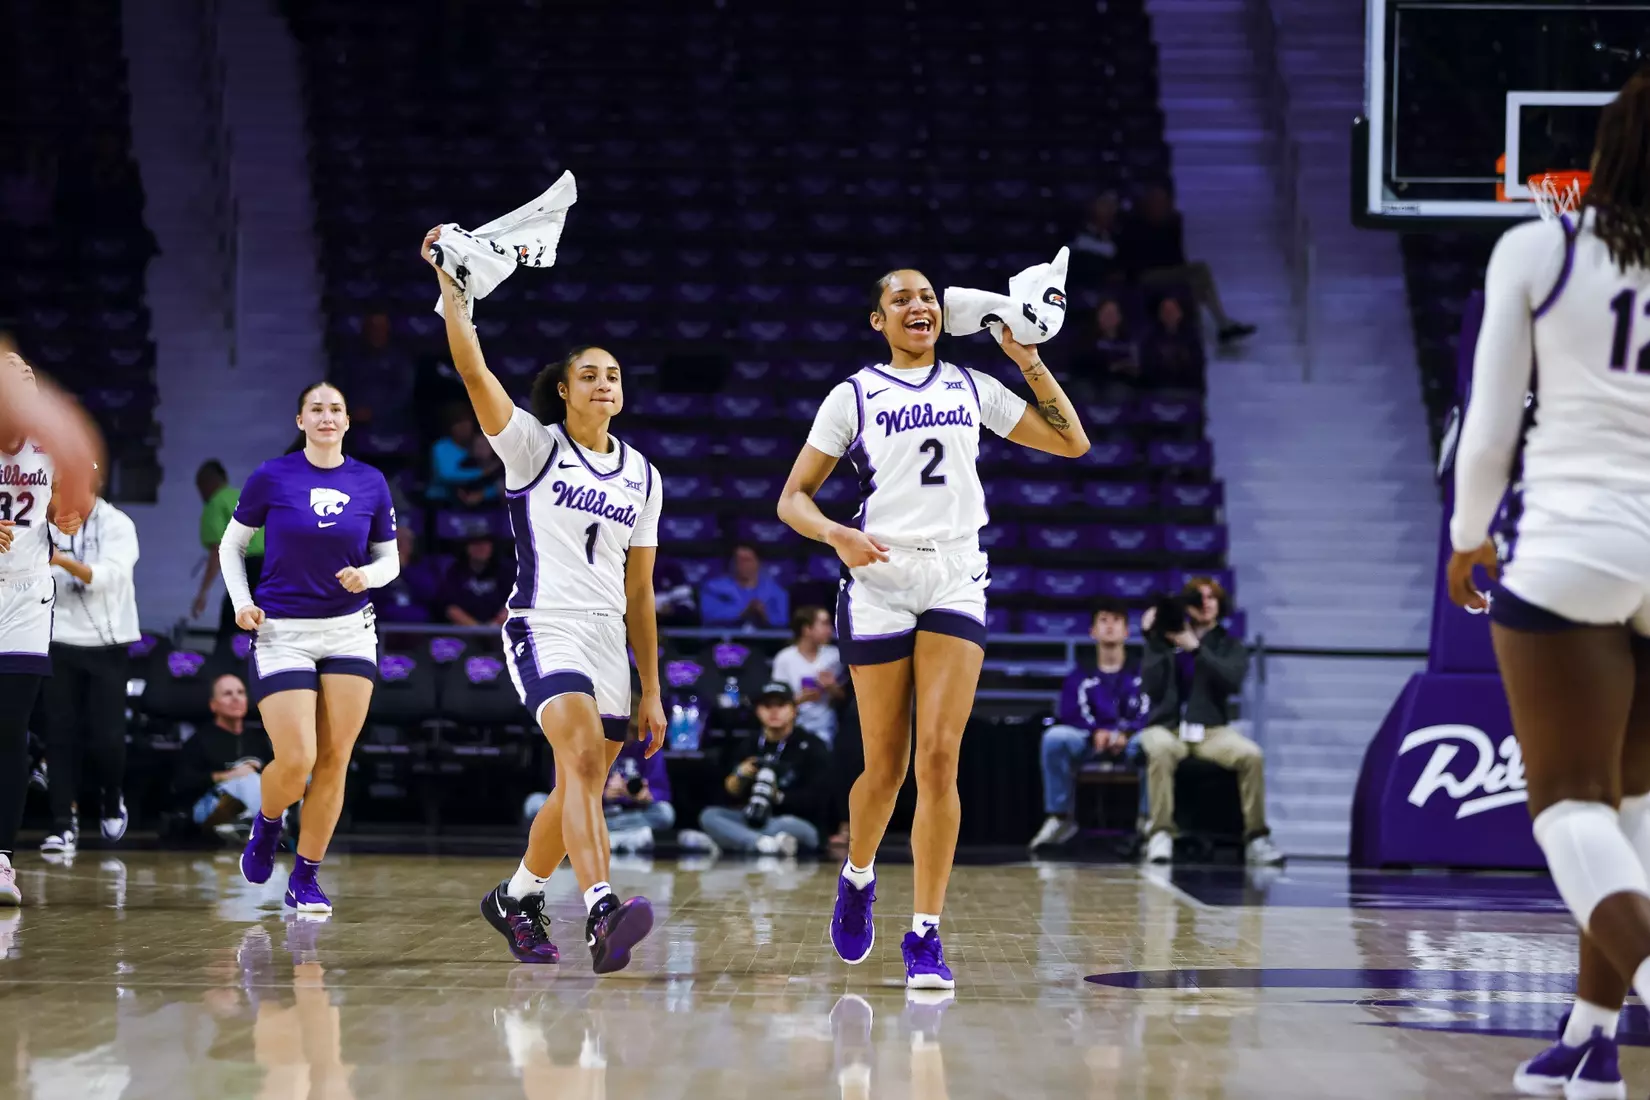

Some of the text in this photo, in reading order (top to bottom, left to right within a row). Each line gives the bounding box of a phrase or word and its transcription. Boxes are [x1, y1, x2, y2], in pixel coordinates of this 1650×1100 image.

[875, 403, 974, 438] Wildcats
[0, 464, 48, 486] ildcats
[919, 438, 947, 487] 2
[0, 491, 35, 527] 32
[551, 480, 638, 528] Wildcats
[584, 521, 600, 565] 1
